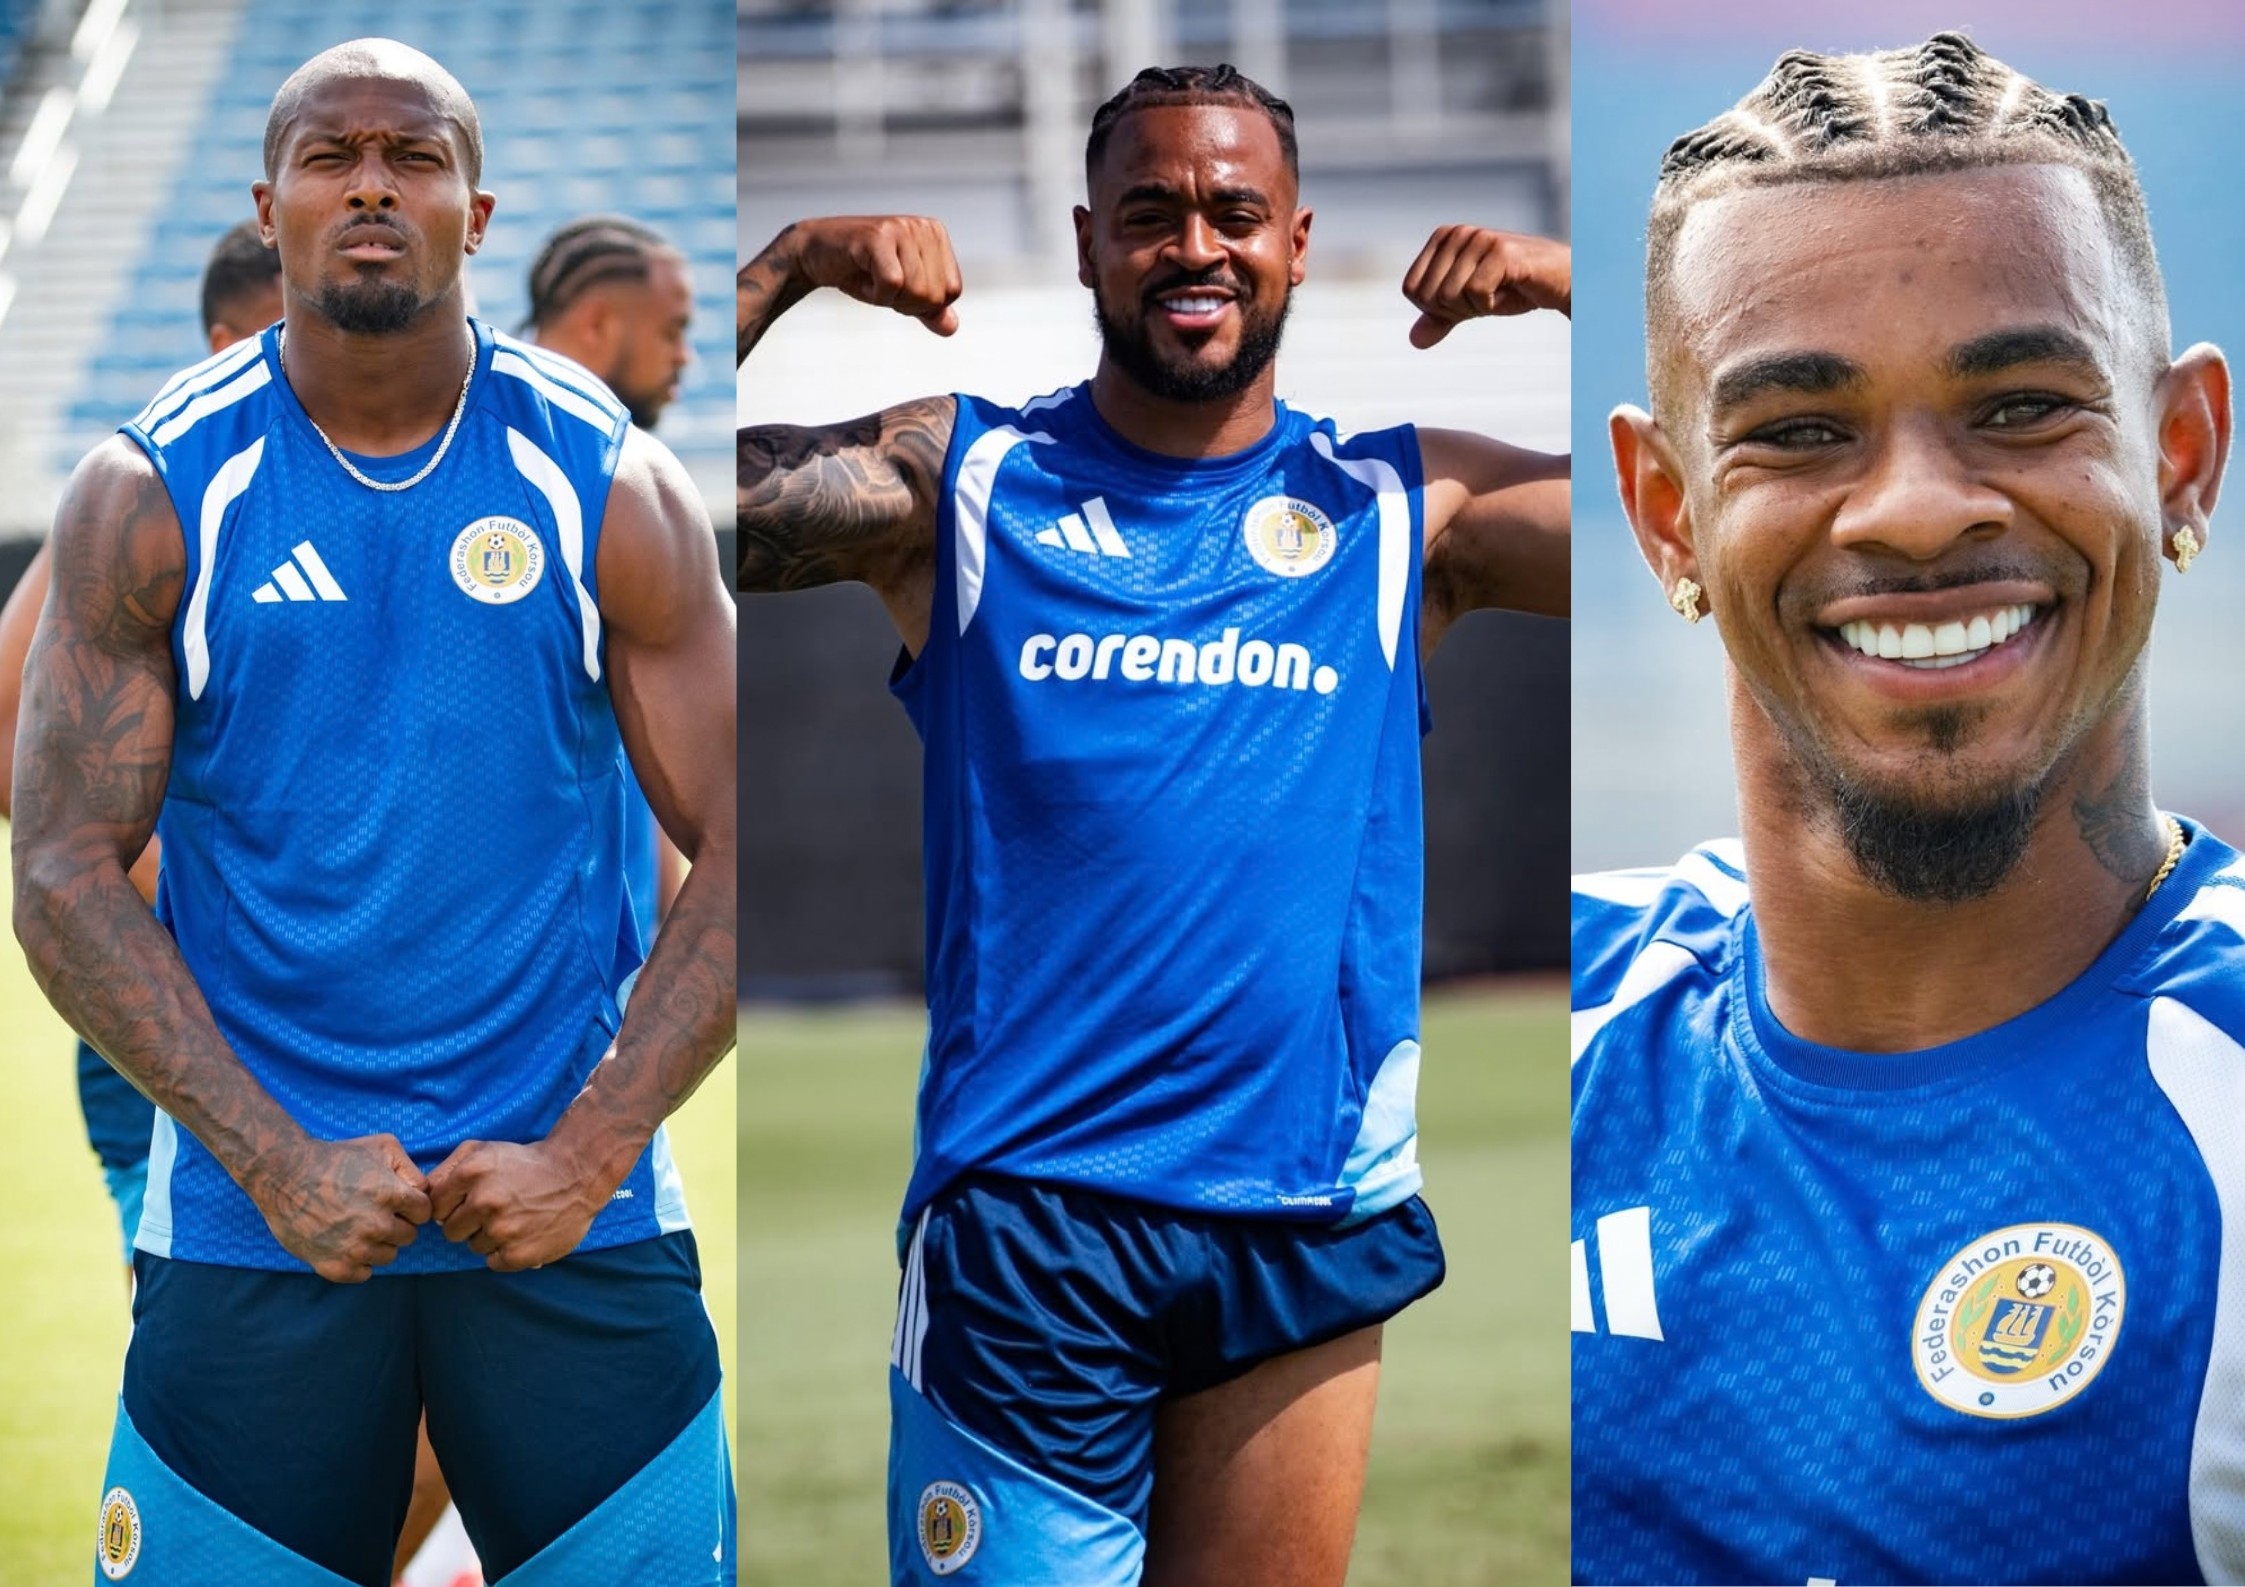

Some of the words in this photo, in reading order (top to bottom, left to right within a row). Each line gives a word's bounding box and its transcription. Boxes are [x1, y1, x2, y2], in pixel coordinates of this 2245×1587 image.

[456, 525, 486, 592] Federashon
[1019, 627, 1338, 694] corendon.
[2033, 1232, 2112, 1286] Futbòl
[1922, 1239, 2020, 1384] Federashon
[2049, 1291, 2116, 1392] Kòrsou
